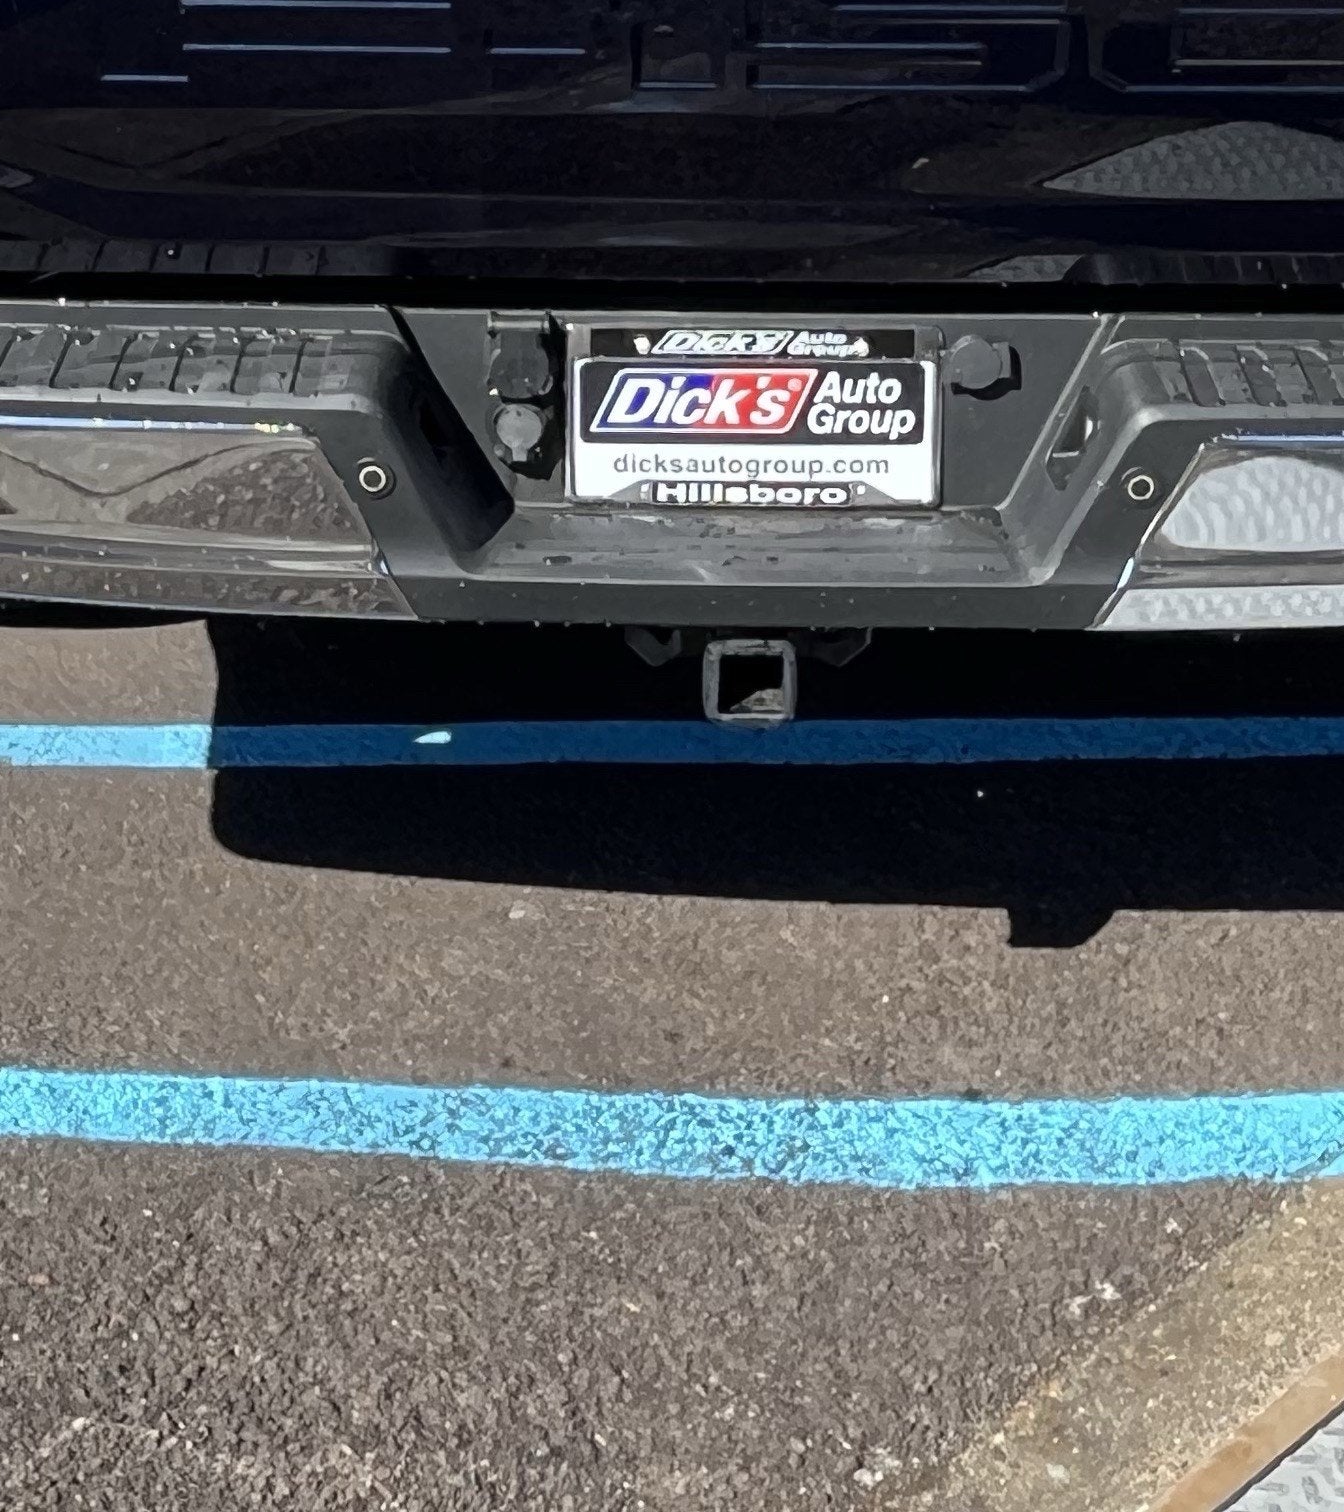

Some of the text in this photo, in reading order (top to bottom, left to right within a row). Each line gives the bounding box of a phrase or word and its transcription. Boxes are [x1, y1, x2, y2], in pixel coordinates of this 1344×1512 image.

[794, 330, 848, 345] Auto
[606, 375, 792, 426] Dick's
[813, 370, 903, 405] Auto
[806, 403, 917, 440] Group
[612, 453, 890, 479] dicksautogroup.com
[656, 482, 848, 504] Hillsboro
